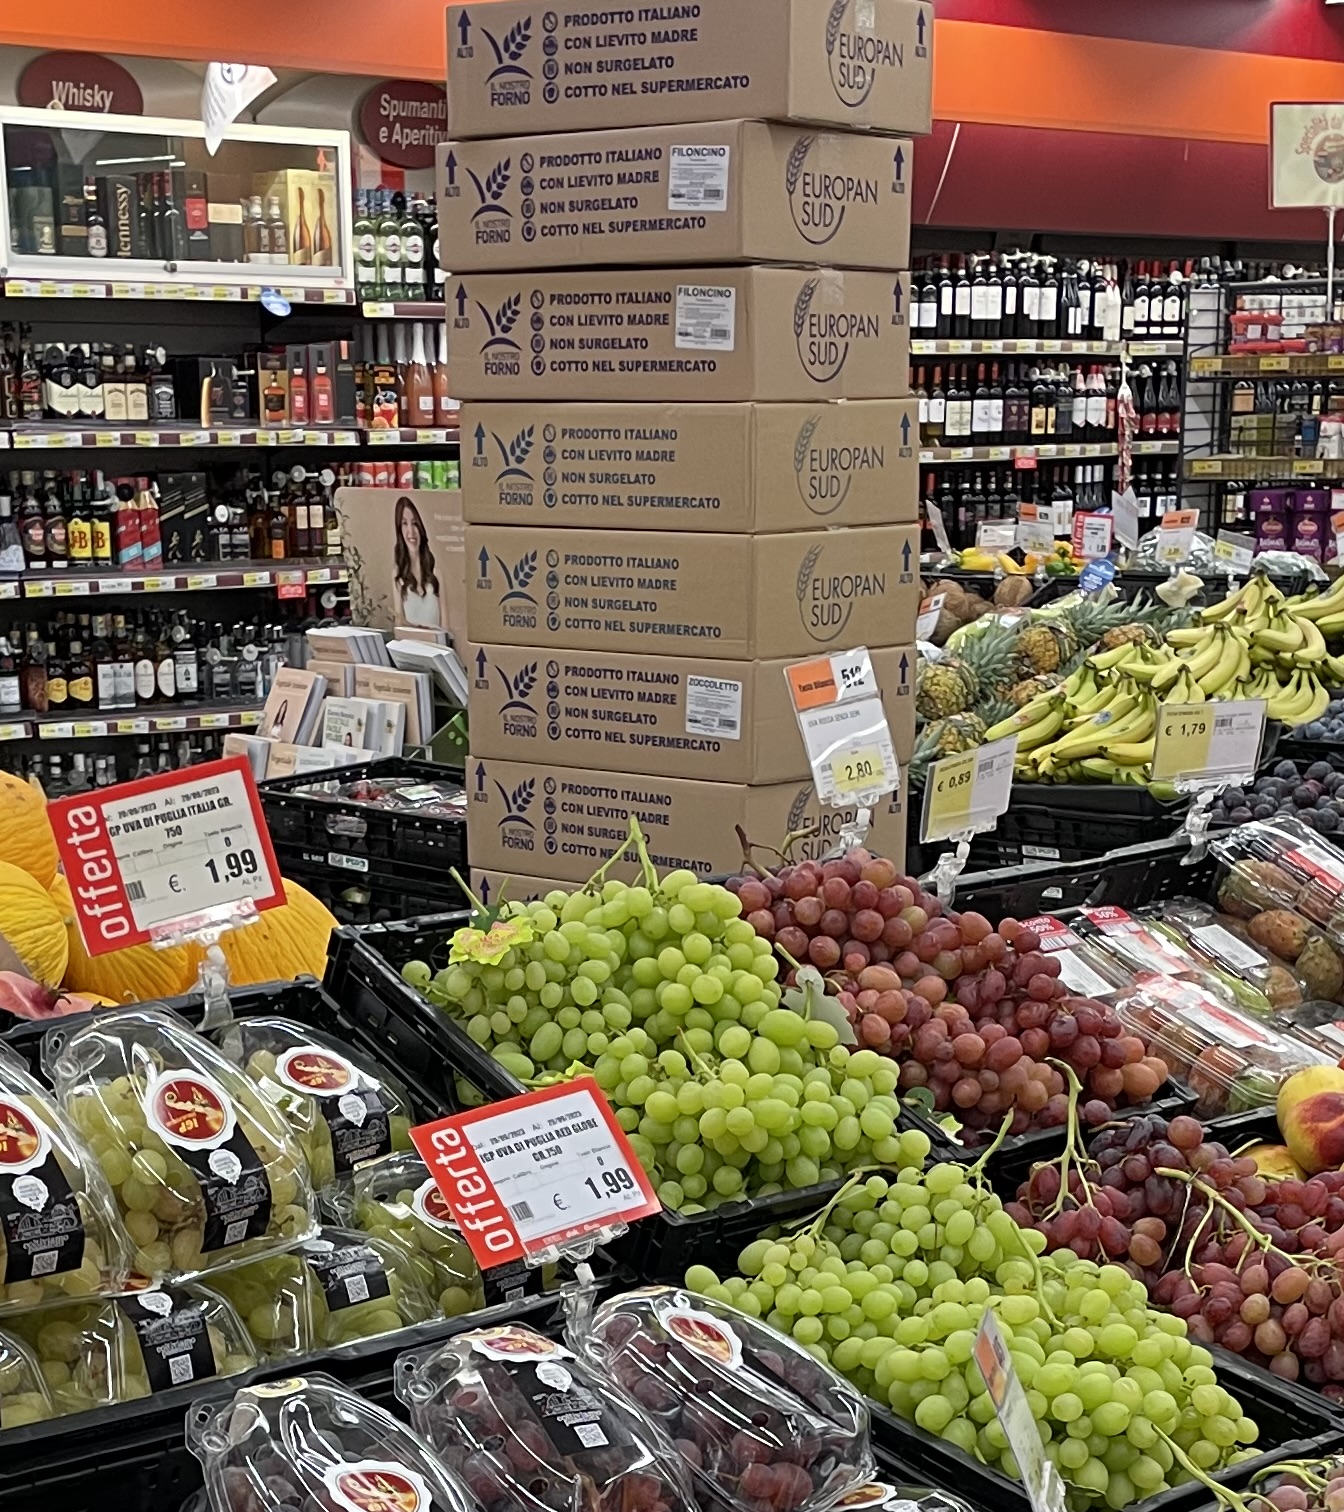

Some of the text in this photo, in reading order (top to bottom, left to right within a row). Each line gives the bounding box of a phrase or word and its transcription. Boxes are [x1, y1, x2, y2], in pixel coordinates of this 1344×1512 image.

[564, 5, 700, 28] PRODOTTO ITALIANO
[565, 29, 698, 50] CON LIEVITO MADRE
[840, 33, 903, 67] EUROPAN
[565, 56, 674, 75] NON SURGELATO
[839, 62, 866, 89] SUD
[52, 80, 113, 114] Whisky
[565, 75, 749, 98] COTTO NEL SUPERMERCATO
[380, 93, 447, 120] Spumanti
[491, 92, 530, 107] FORNO
[392, 126, 447, 147] Aperitiv
[540, 148, 662, 168] PRODOTTO ITALIANO
[672, 147, 726, 157] FILONCINO
[540, 170, 659, 190] CON LIEVITO MADRE
[803, 173, 878, 205] EUROPAN
[540, 197, 638, 214] NON SURGELATO
[802, 201, 834, 227] SUD
[476, 230, 510, 244] FORNO
[541, 216, 705, 236] COTTO NEL SUPERMERCATO
[550, 292, 672, 305] PRODOTTO ITALIANO
[678, 287, 731, 298] FILONCINO
[810, 314, 879, 338] EUROPAN
[808, 341, 838, 365] SUD
[485, 362, 520, 375] FORNO
[1180, 722, 1206, 736] 1,79
[845, 760, 872, 782] 2,80
[949, 771, 971, 790] 0,89
[124, 821, 141, 833] UVA
[145, 817, 154, 827] DI
[155, 808, 185, 825] PUGLIA
[188, 801, 217, 816] ITALIA
[165, 826, 182, 838] 750
[67, 805, 130, 940] offerta
[205, 849, 258, 884] 1,99
[480, 1149, 495, 1163] IGP
[525, 1132, 555, 1149] PUGLIA
[557, 1127, 571, 1140] RED
[572, 1118, 598, 1135] GLOBE
[432, 1128, 514, 1252] offerta
[585, 1167, 634, 1200] 1,99
